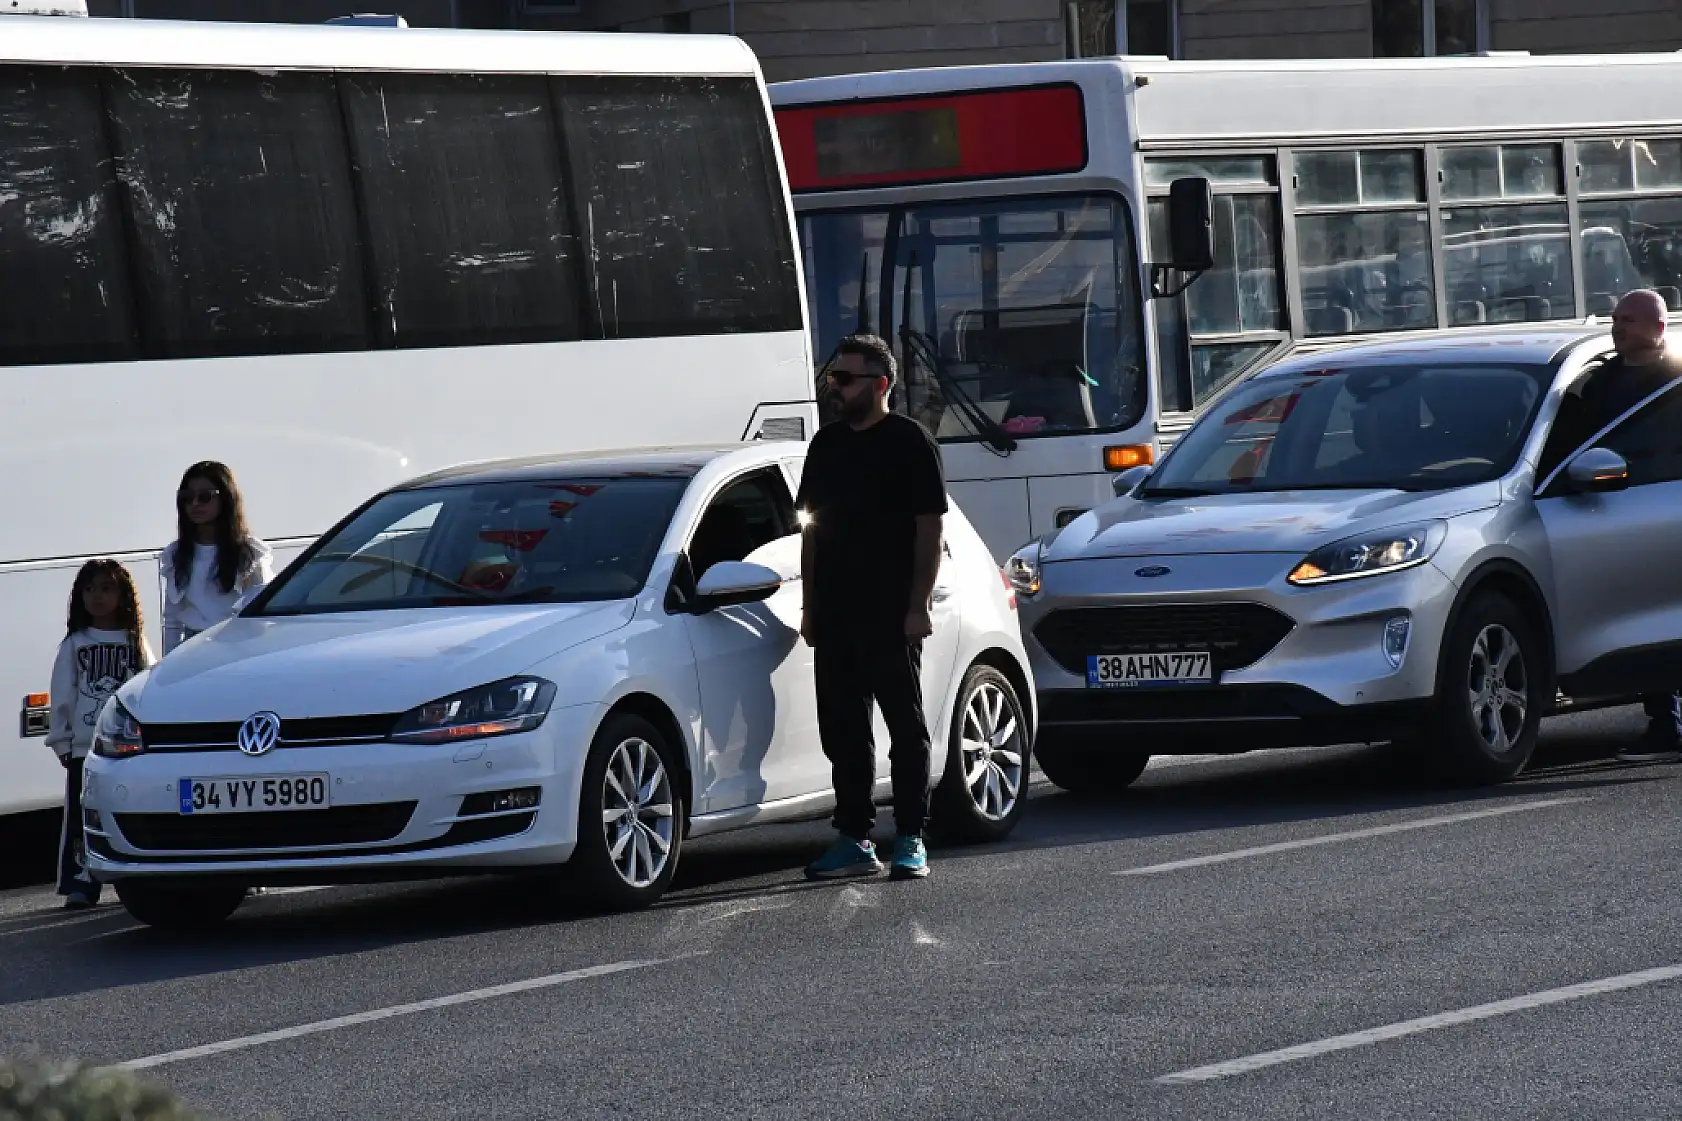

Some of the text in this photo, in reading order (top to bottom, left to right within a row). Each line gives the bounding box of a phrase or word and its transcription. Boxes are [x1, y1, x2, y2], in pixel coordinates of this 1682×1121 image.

[192, 777, 324, 810] 34 VY 5980
